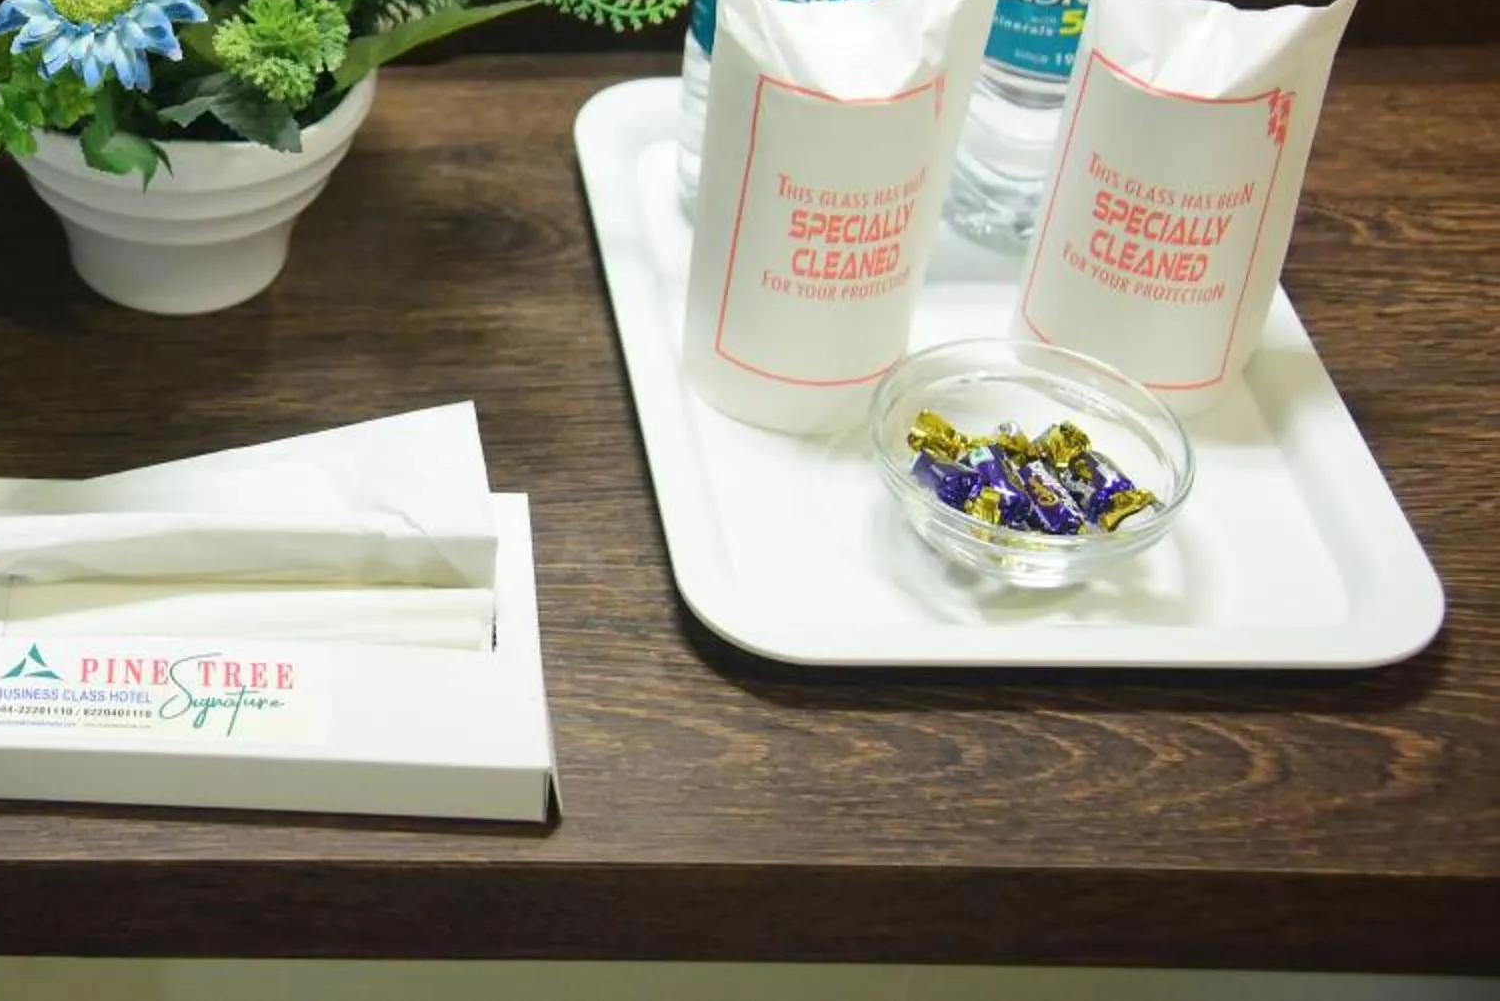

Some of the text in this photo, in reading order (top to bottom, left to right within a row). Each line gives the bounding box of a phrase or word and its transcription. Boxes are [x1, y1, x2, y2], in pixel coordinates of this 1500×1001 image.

[995, 14, 1053, 36] inerals
[820, 188, 868, 208] GLASS
[874, 185, 900, 207] HAS
[1124, 179, 1175, 206] GLASS
[1182, 193, 1212, 210] HAS
[1217, 182, 1255, 209] BEEN
[788, 198, 914, 244] SPECIALLY
[1092, 189, 1233, 247] SPECIALLY
[791, 242, 900, 280] CLEANED
[1090, 228, 1209, 283] CLEANED
[797, 280, 837, 300] YOUR
[1092, 265, 1131, 294] YOUR
[1134, 281, 1226, 305] PROTECTION
[79, 656, 295, 691] PINE TREE
[62, 688, 105, 703] CLASS
[108, 690, 153, 705] HOTEL
[159, 652, 286, 737] Signature
